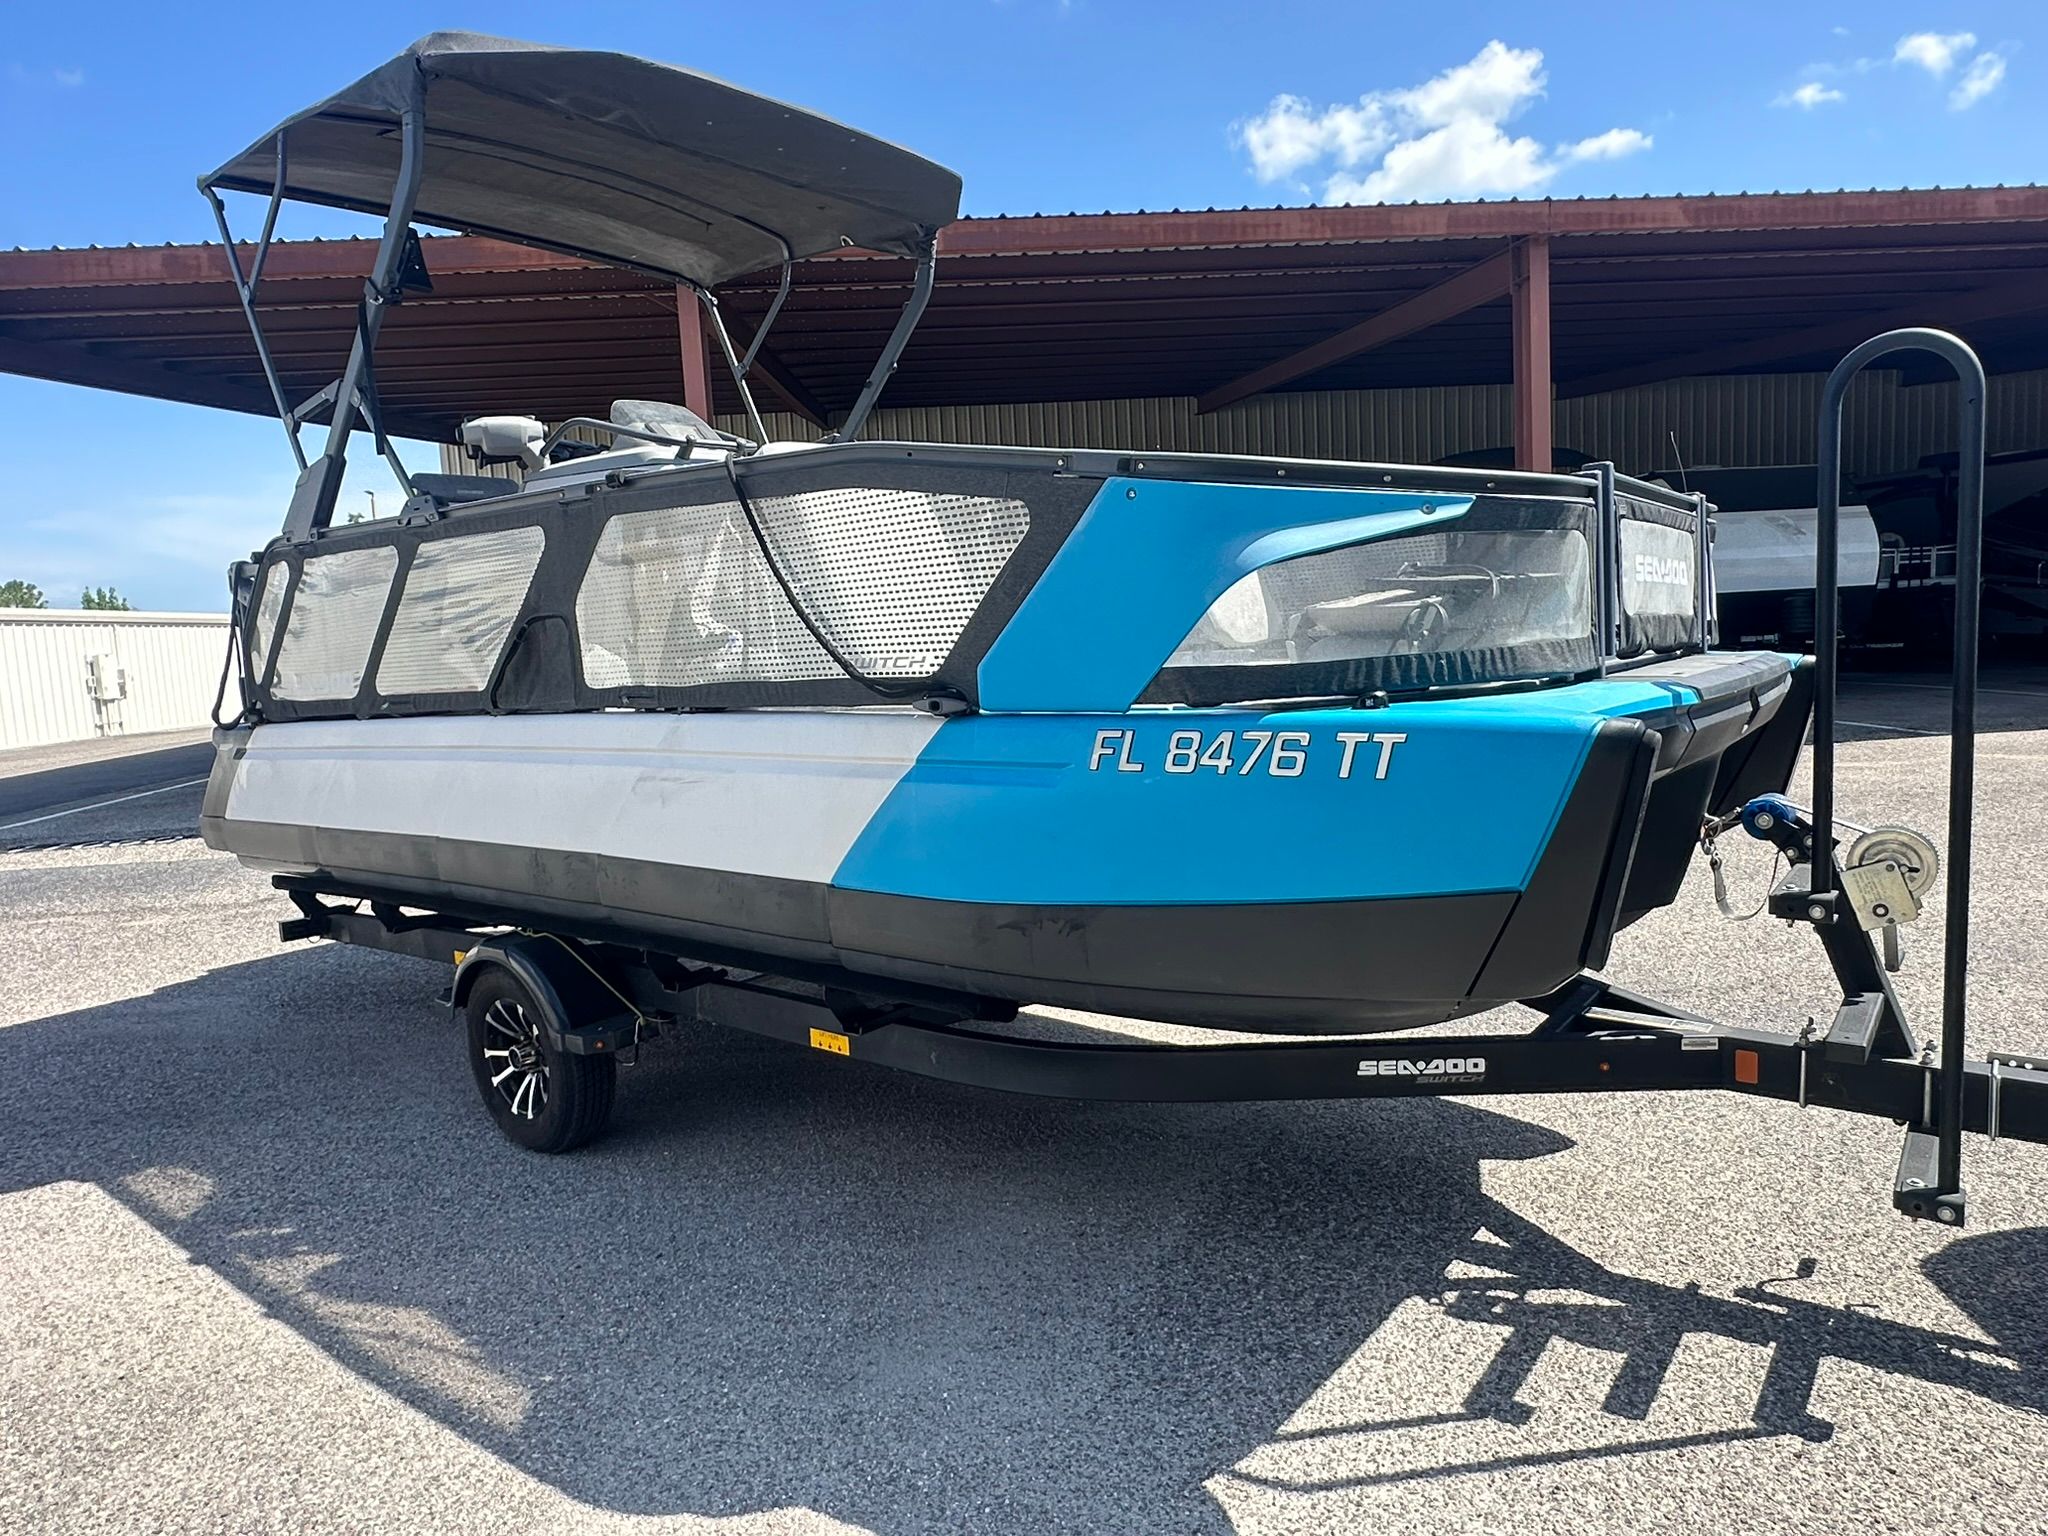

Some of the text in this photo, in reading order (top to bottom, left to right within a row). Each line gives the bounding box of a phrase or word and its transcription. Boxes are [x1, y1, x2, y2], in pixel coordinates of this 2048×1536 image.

[847, 656, 927, 669] WITCH
[1088, 729, 1408, 780] FL 8476 TT
[1415, 1075, 1486, 1084] SWITCH
